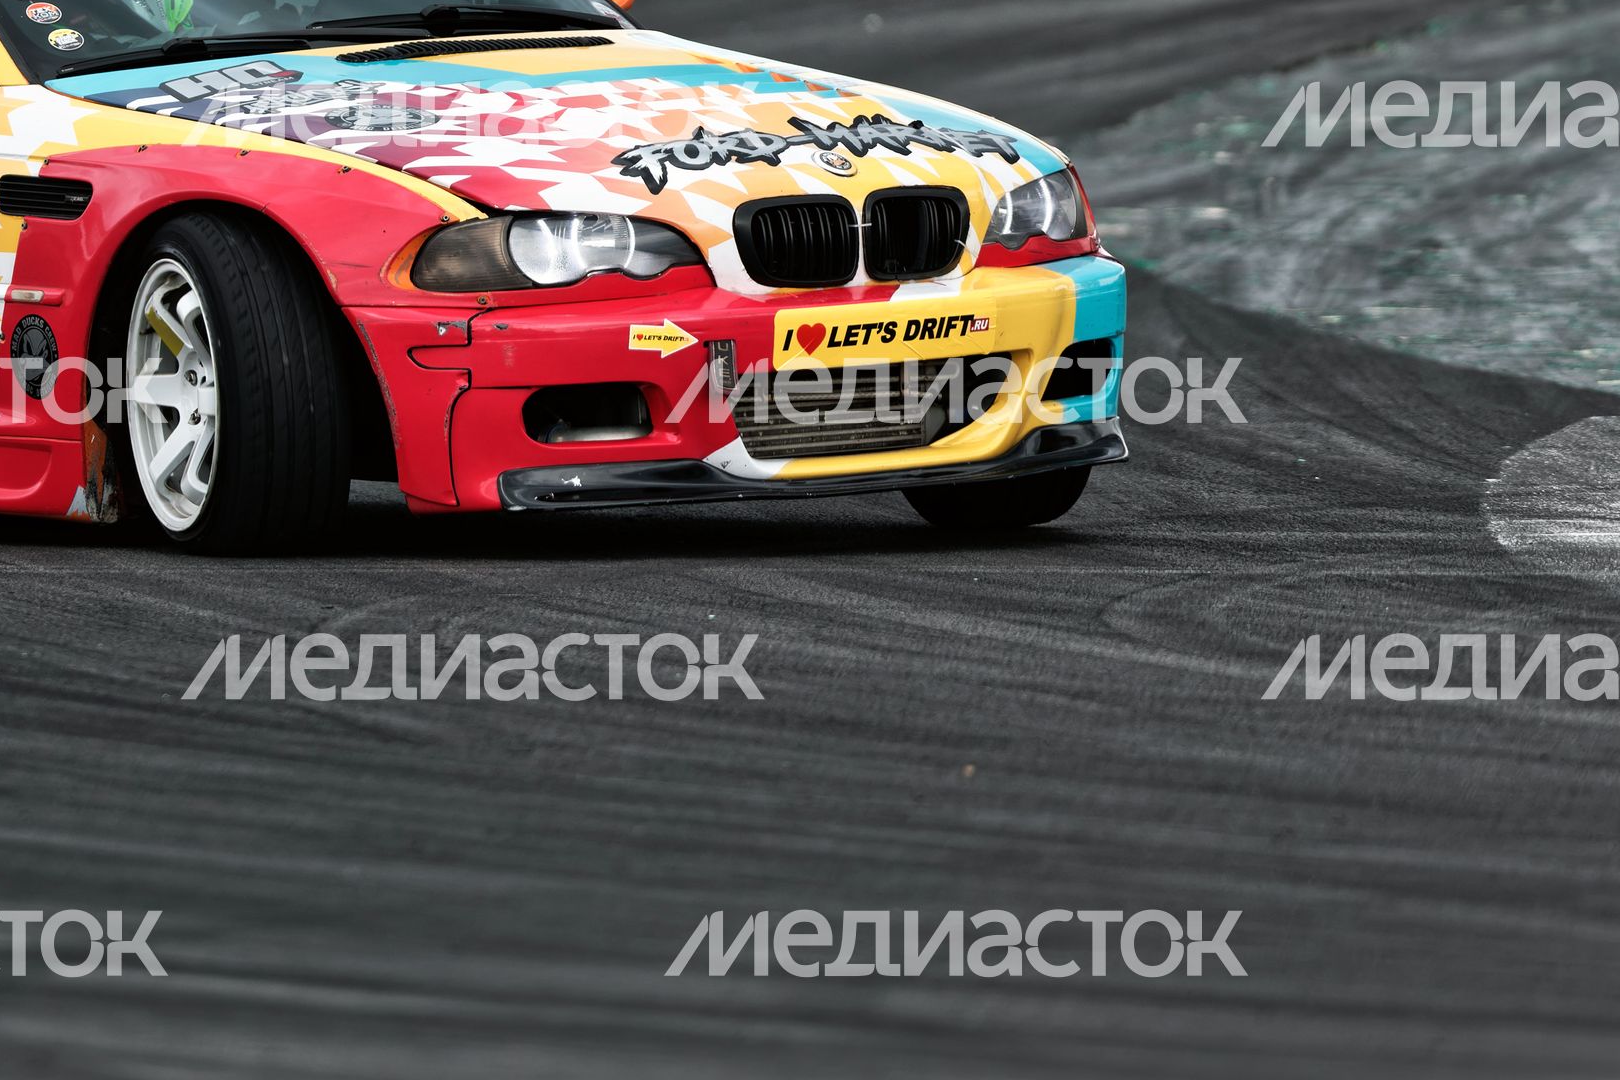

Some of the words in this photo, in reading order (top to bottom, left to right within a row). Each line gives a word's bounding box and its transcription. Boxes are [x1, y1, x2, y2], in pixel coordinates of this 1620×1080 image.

[22, 316, 45, 329] DUCKS
[783, 330, 794, 351] I
[827, 321, 898, 348] LET'S
